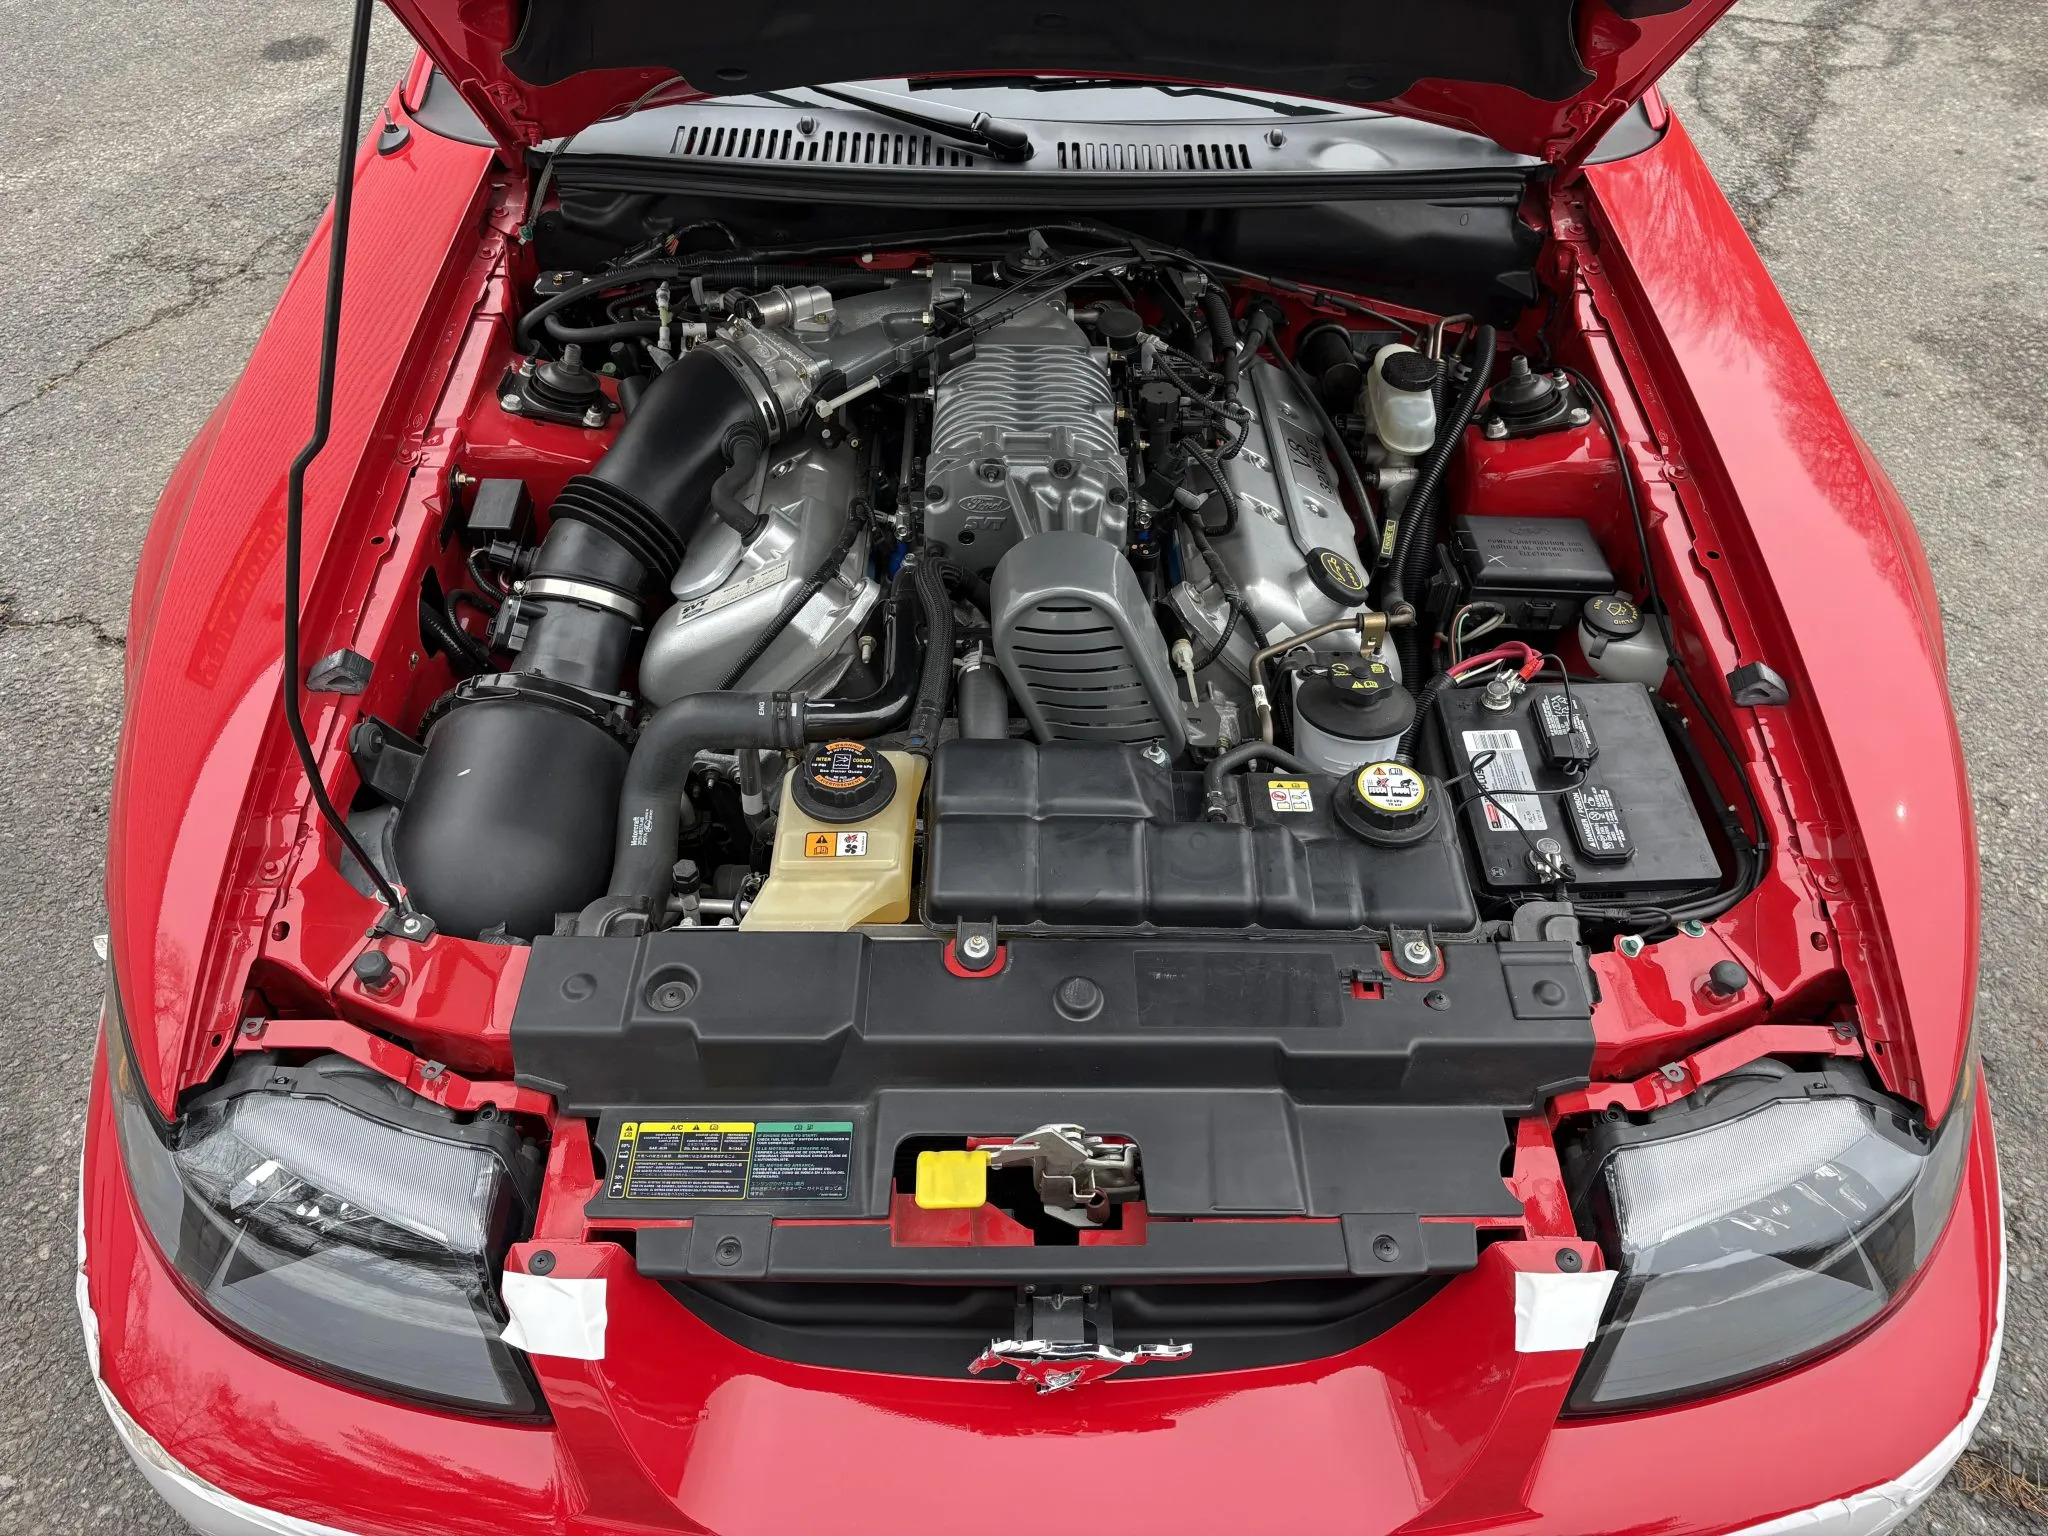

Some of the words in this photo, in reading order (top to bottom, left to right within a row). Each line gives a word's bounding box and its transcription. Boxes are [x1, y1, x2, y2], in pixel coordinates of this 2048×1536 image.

[1287, 437, 1312, 469] V8
[966, 497, 1005, 511] Ford
[964, 515, 1007, 530] SVT
[682, 598, 709, 615] SVT
[1572, 792, 1585, 814] POISON
[630, 816, 640, 846] Motorcraft
[1581, 818, 1595, 842] DANGER
